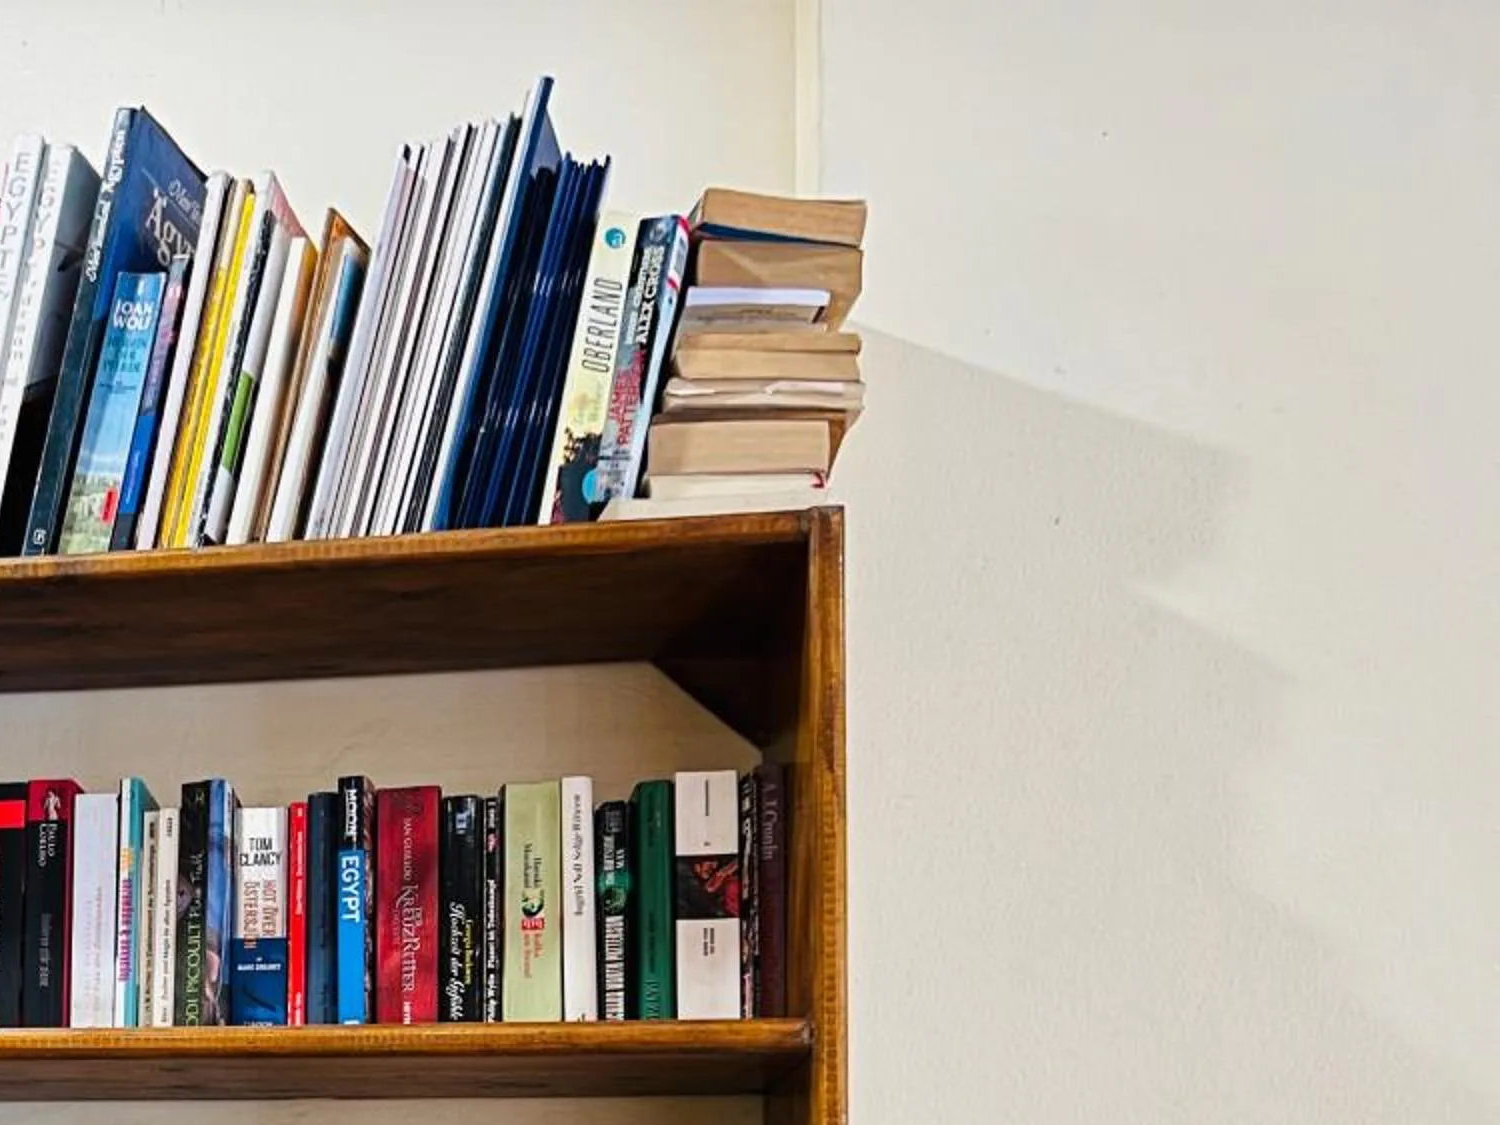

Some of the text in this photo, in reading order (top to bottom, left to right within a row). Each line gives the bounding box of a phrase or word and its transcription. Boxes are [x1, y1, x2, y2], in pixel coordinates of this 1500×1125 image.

[115, 300, 153, 318] JOAN
[639, 247, 664, 345] ALEX CROSS
[582, 277, 622, 373] OBERLAND
[345, 789, 357, 836] MOON
[240, 853, 281, 866] CLANCY
[247, 838, 273, 850] TOM
[262, 880, 276, 904] HOT
[342, 855, 358, 922] EGYPT
[449, 902, 463, 955] Hochzeit
[186, 922, 201, 1026] ODI PICOULT
[450, 958, 462, 976] der
